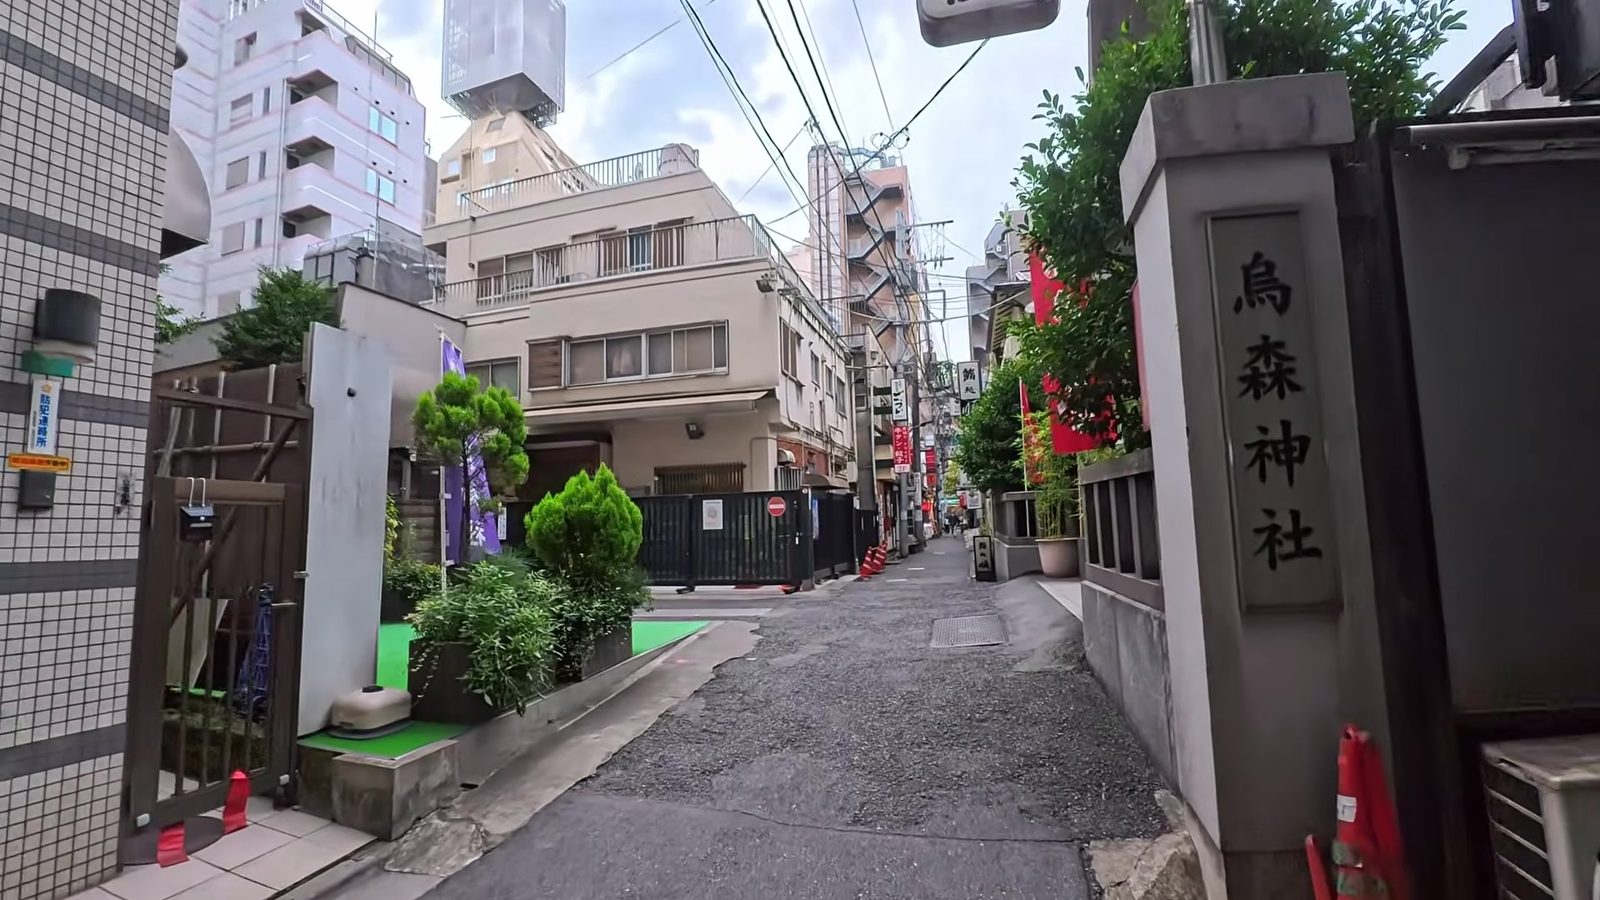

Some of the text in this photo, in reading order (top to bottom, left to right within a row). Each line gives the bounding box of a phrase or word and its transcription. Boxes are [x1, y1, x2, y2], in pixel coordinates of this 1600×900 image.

[36, 393, 51, 448] 防犯連絡所
[1233, 250, 1323, 570] 烏森神社
